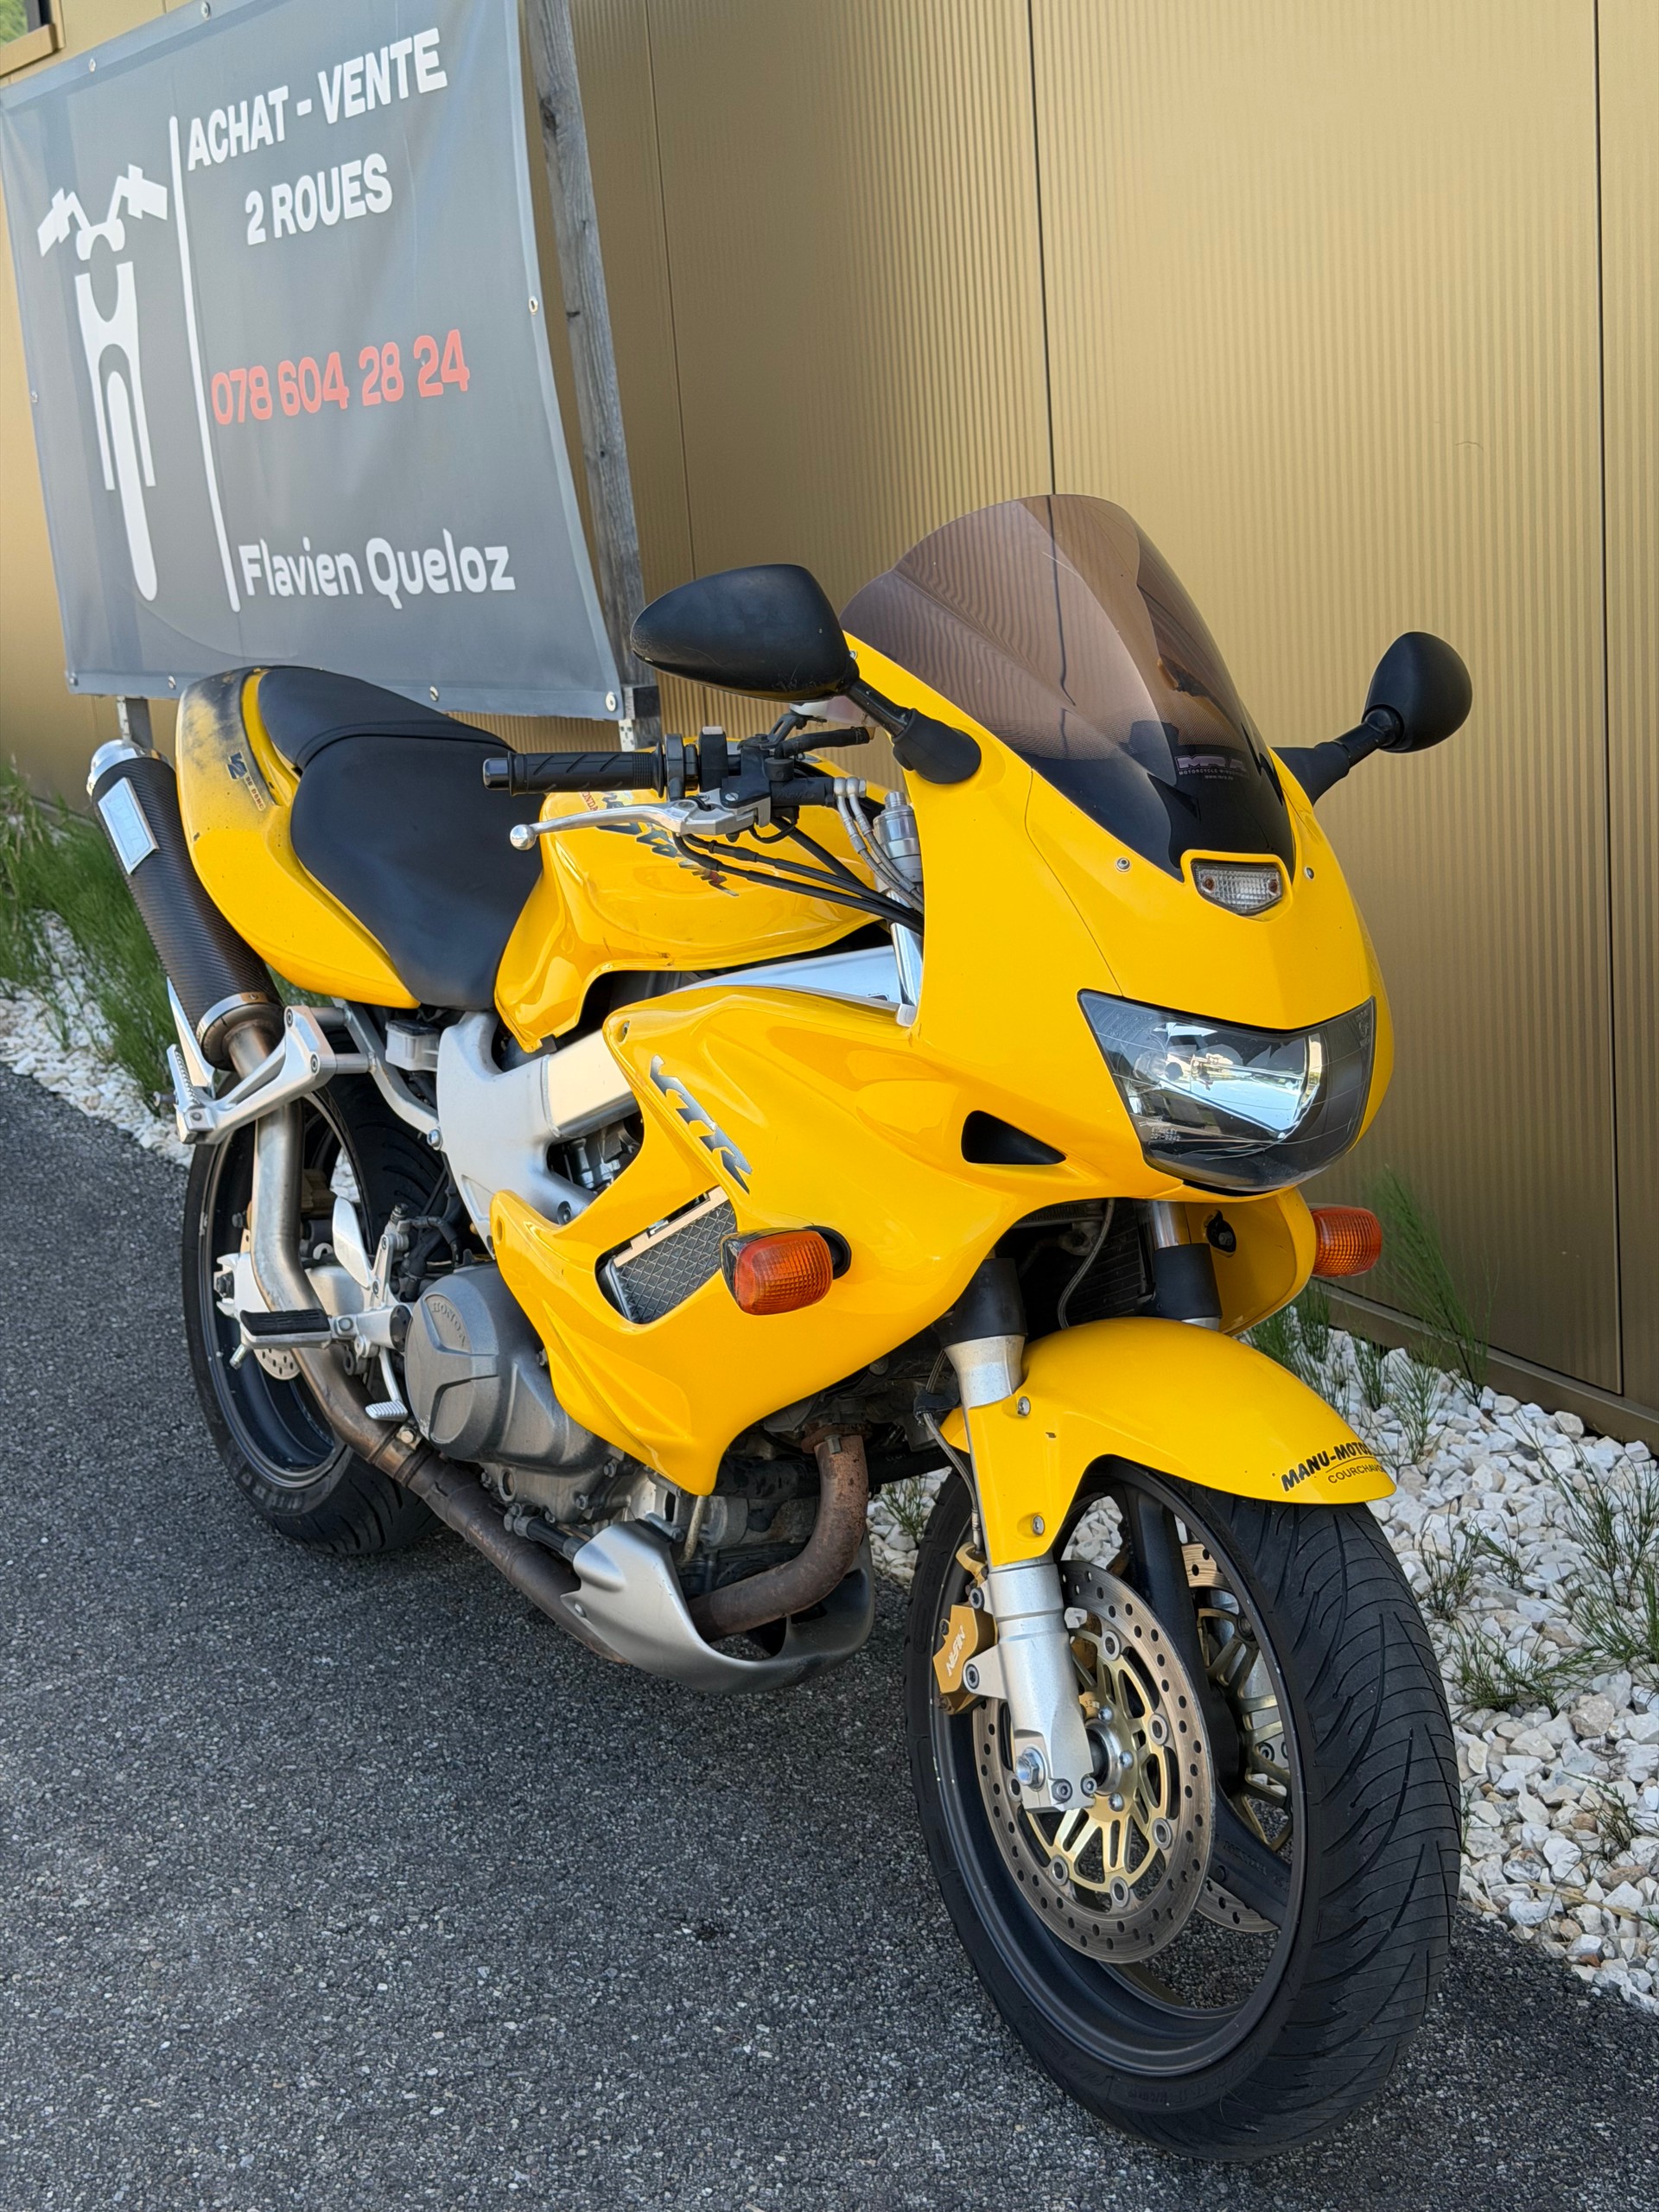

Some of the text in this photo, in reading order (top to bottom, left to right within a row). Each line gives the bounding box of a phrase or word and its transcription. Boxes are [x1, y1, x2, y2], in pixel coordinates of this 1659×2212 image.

[188, 86, 289, 171] ACHAT
[317, 28, 448, 124] VENTE
[244, 154, 392, 245] 2 ROUES
[212, 330, 470, 425] 078 604 28 24
[239, 529, 516, 609] Flavien Queloz
[650, 1054, 753, 1195] VTR
